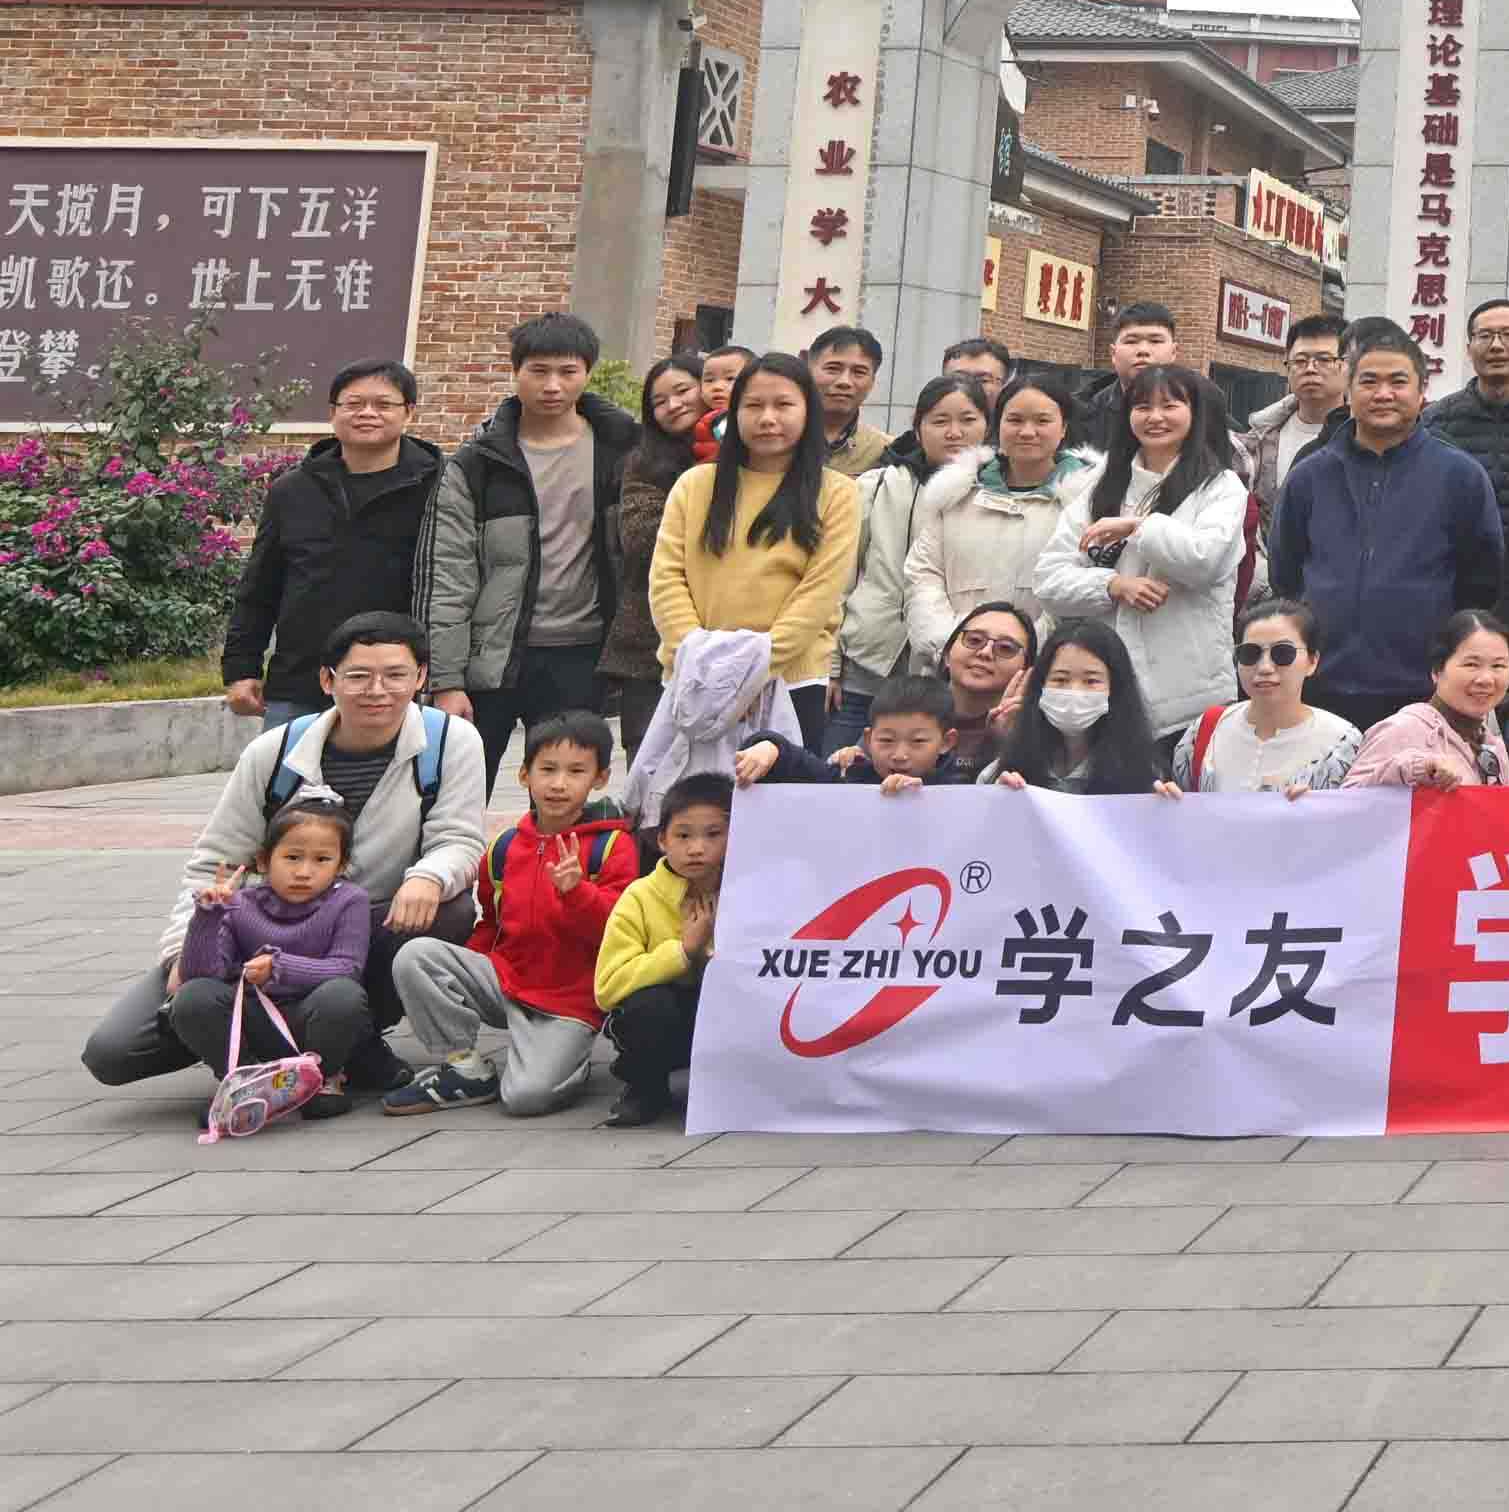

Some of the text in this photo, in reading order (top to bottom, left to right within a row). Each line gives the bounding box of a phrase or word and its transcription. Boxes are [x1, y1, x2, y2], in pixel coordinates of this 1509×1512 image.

[5, 183, 379, 240] 天揽月，可下五洋
[800, 71, 861, 358] 农业学大
[758, 948, 983, 979] XUE ZHI YOU
[995, 903, 1343, 1027] 学之友
